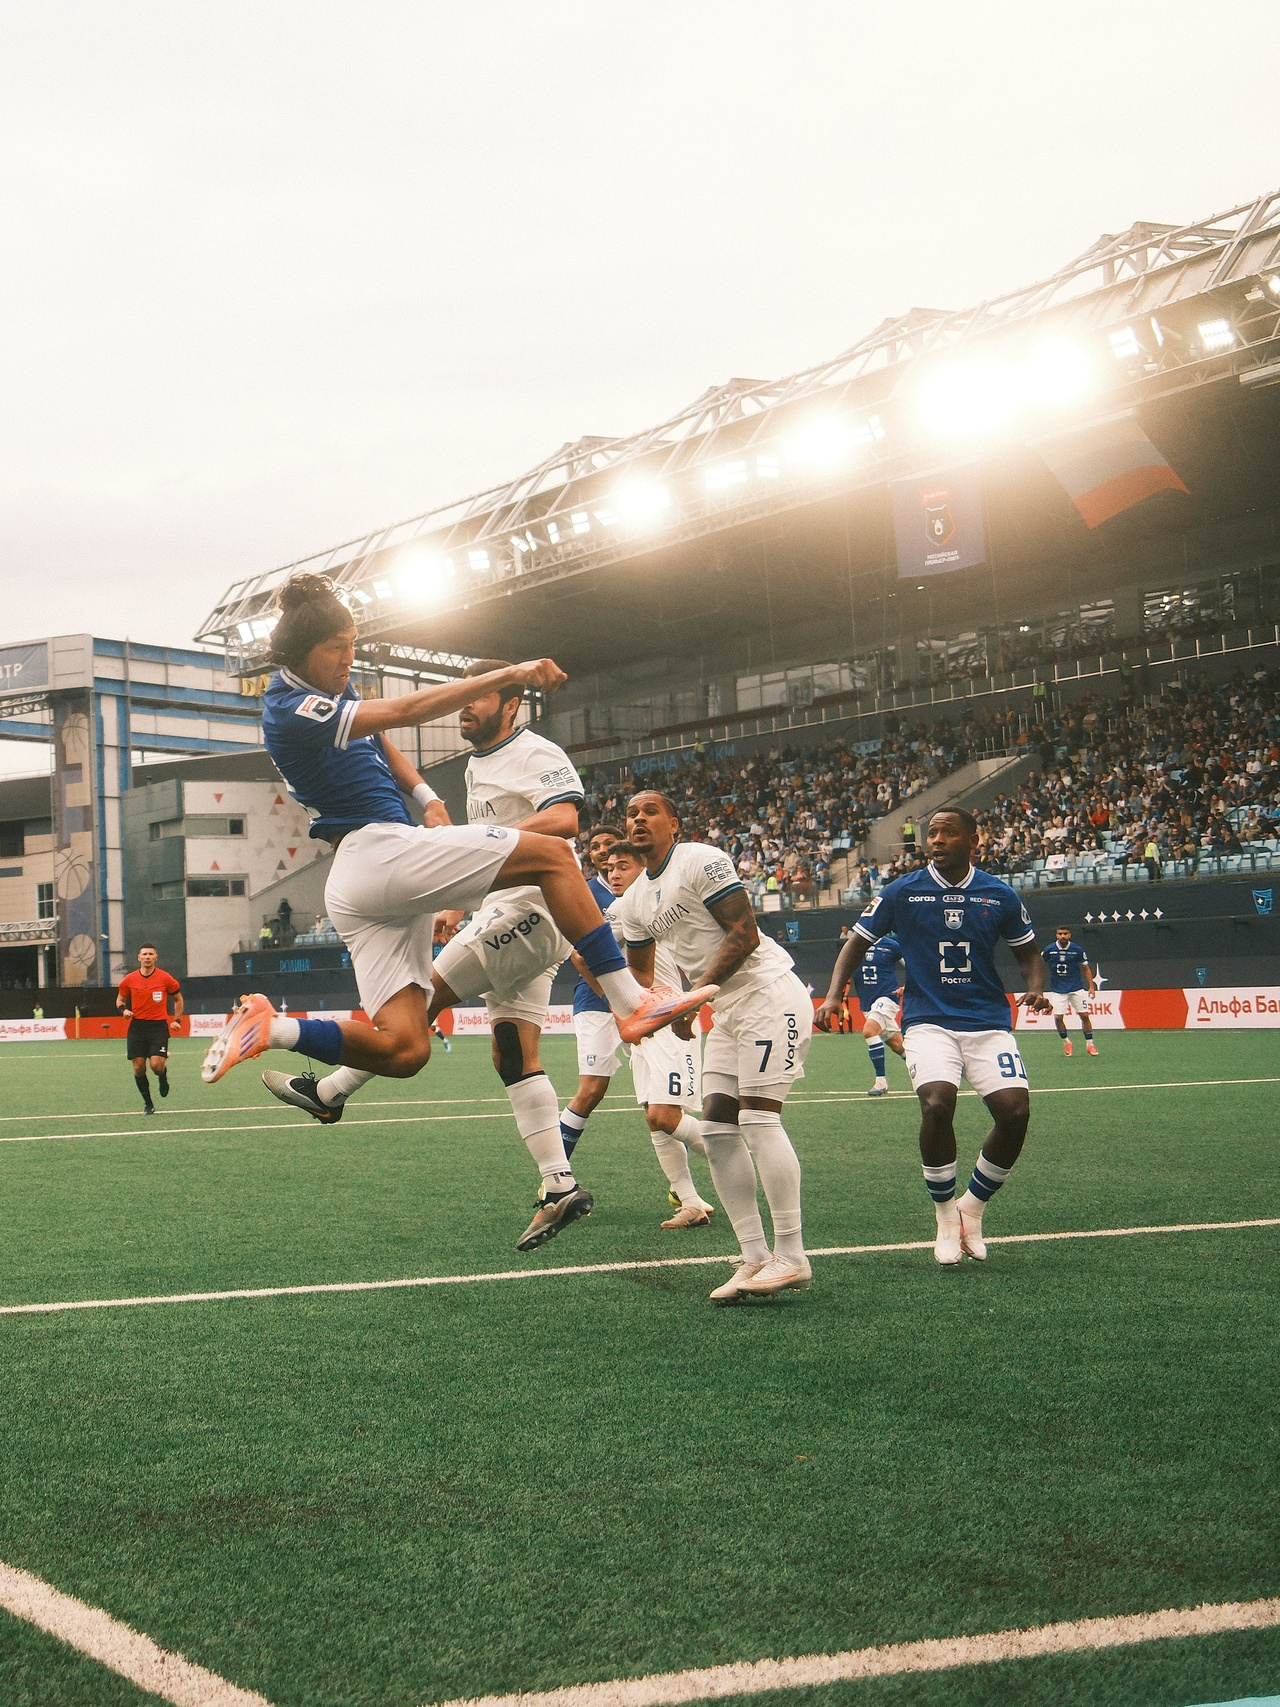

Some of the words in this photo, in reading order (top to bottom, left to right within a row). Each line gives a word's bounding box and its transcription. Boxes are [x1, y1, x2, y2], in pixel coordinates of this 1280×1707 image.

[485, 912, 545, 950] Vorgo
[544, 1011, 571, 1026] Альфа
[1197, 995, 1252, 1018] Альфа
[1255, 995, 1280, 1014] Ба
[0, 1024, 31, 1036] Альфа
[34, 1023, 58, 1033] Банк
[458, 1013, 483, 1026] Альфа
[784, 1013, 799, 1070] Vorgol
[755, 1040, 773, 1073] 7
[668, 1072, 681, 1097] 6
